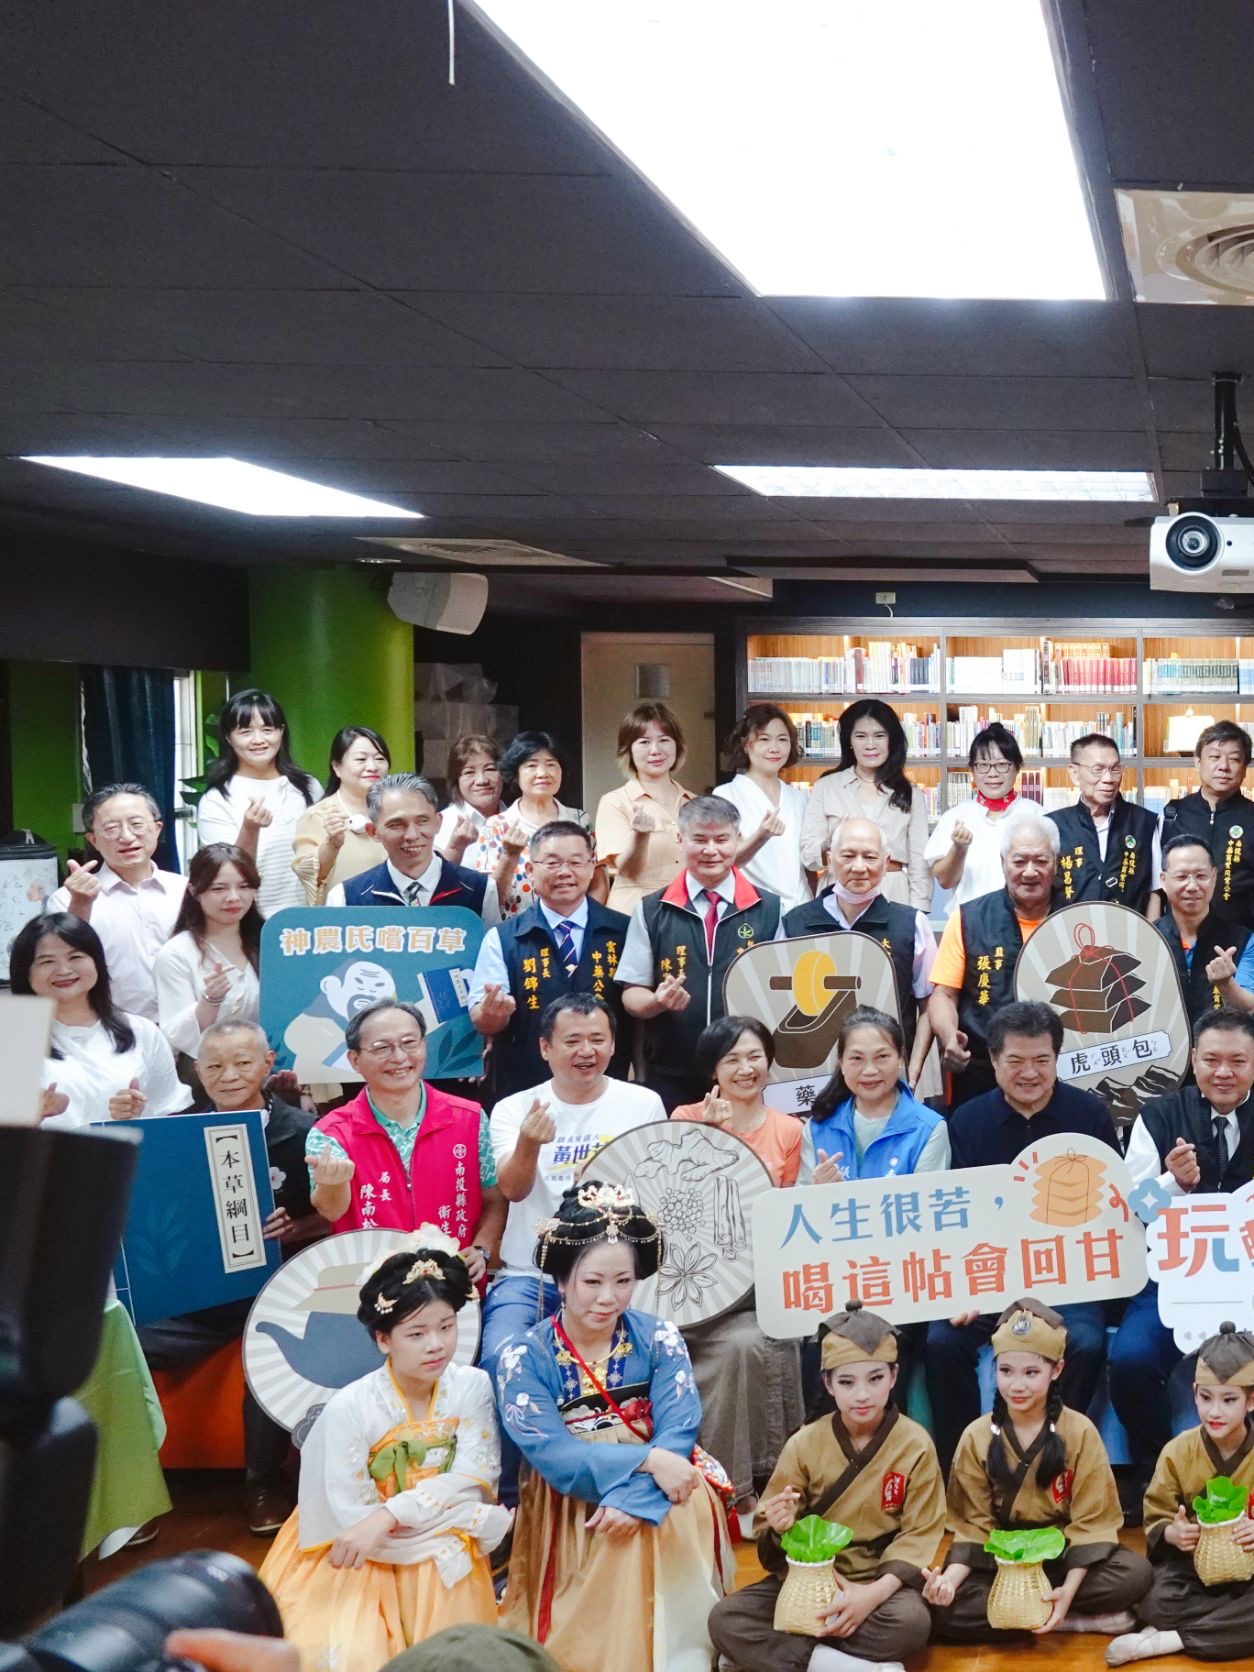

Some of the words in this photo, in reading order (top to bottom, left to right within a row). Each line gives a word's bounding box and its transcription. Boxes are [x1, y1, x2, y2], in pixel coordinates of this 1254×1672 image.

[280, 925, 467, 956] 神農氏嚐百草
[1070, 1039, 1153, 1074] 虎頭包
[454, 1160, 469, 1239] 南投縣政府
[782, 1228, 1125, 1315] 喝這帖會回甘
